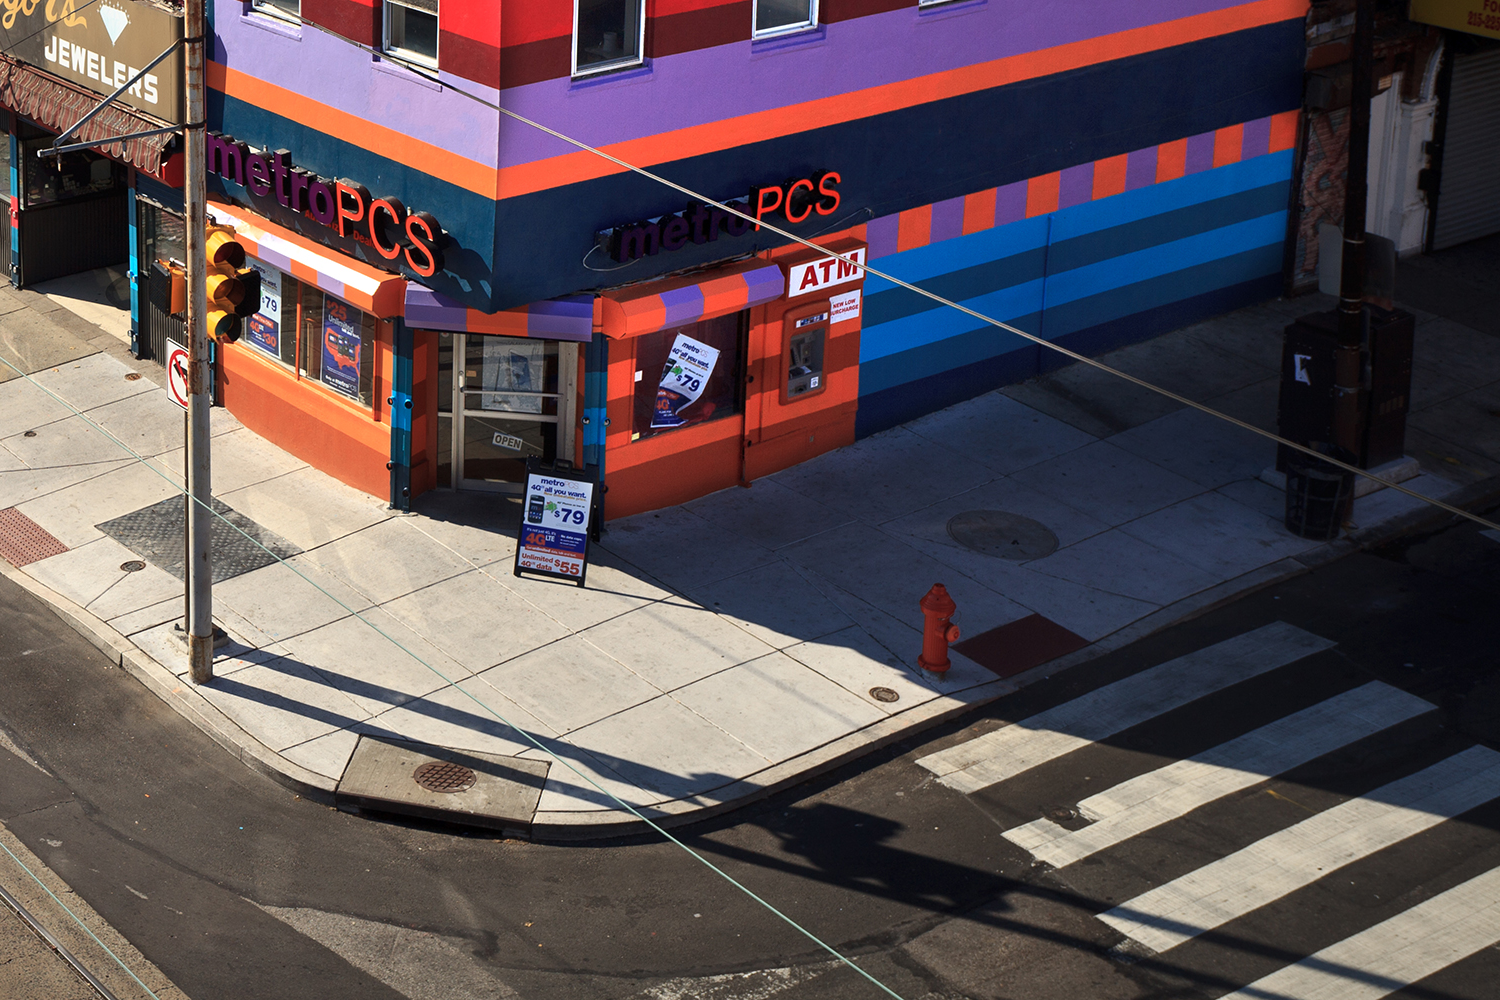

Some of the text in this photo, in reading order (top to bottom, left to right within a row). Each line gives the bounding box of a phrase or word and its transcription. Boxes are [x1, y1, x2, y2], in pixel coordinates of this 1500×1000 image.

[44, 35, 158, 105] JEWELERS
[206, 131, 436, 277] metroPCS
[619, 171, 841, 263] metroPCS
[799, 251, 859, 291] ATM
[326, 300, 348, 321] $25
[845, 298, 856, 306] LOW
[328, 314, 355, 333] Unlimited
[681, 342, 709, 358] metroPCS
[687, 354, 698, 362] you
[675, 374, 701, 392] $79
[494, 434, 522, 450] OPEN
[540, 478, 580, 490] metroPCS
[568, 490, 587, 499] want.
[554, 508, 585, 525] $79
[525, 532, 546, 546] 4G
[545, 534, 556, 543] LTE
[522, 553, 554, 563] Unlimited
[536, 563, 552, 571] data
[554, 559, 580, 576] $55
